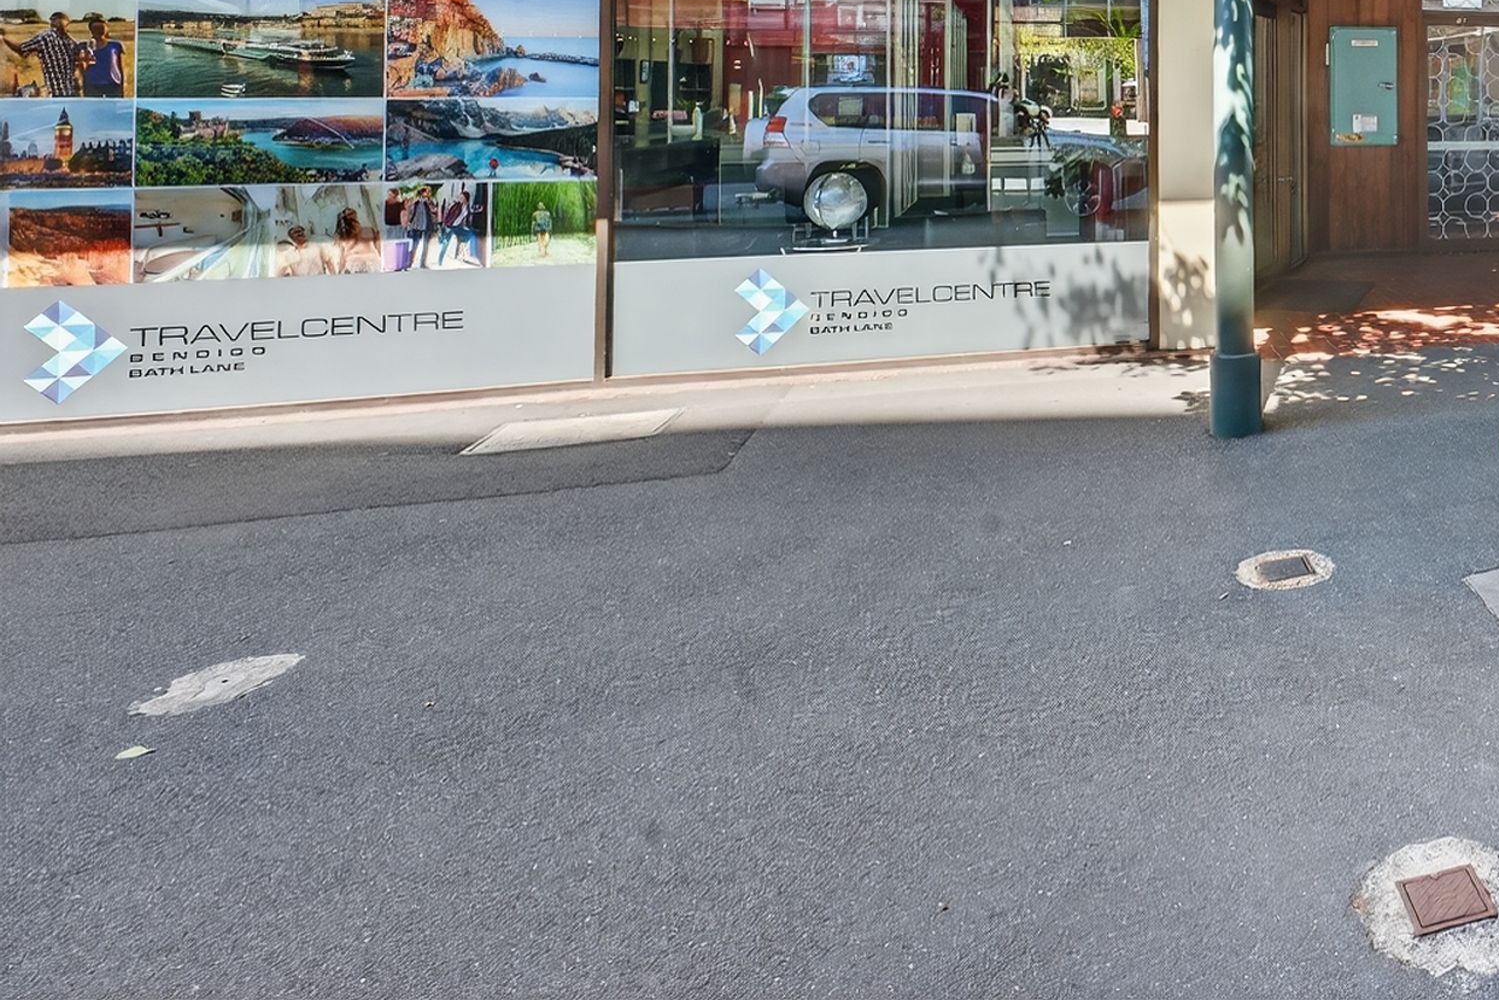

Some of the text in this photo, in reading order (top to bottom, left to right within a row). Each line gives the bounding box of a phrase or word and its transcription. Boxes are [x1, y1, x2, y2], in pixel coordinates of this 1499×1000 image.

[809, 280, 1051, 308] TRAVELCENTRE
[129, 310, 465, 348] TRAVELCENTRE
[809, 321, 894, 336] BATH LANE
[129, 346, 267, 364] BENDIGO
[128, 362, 246, 379] BATH LANE
